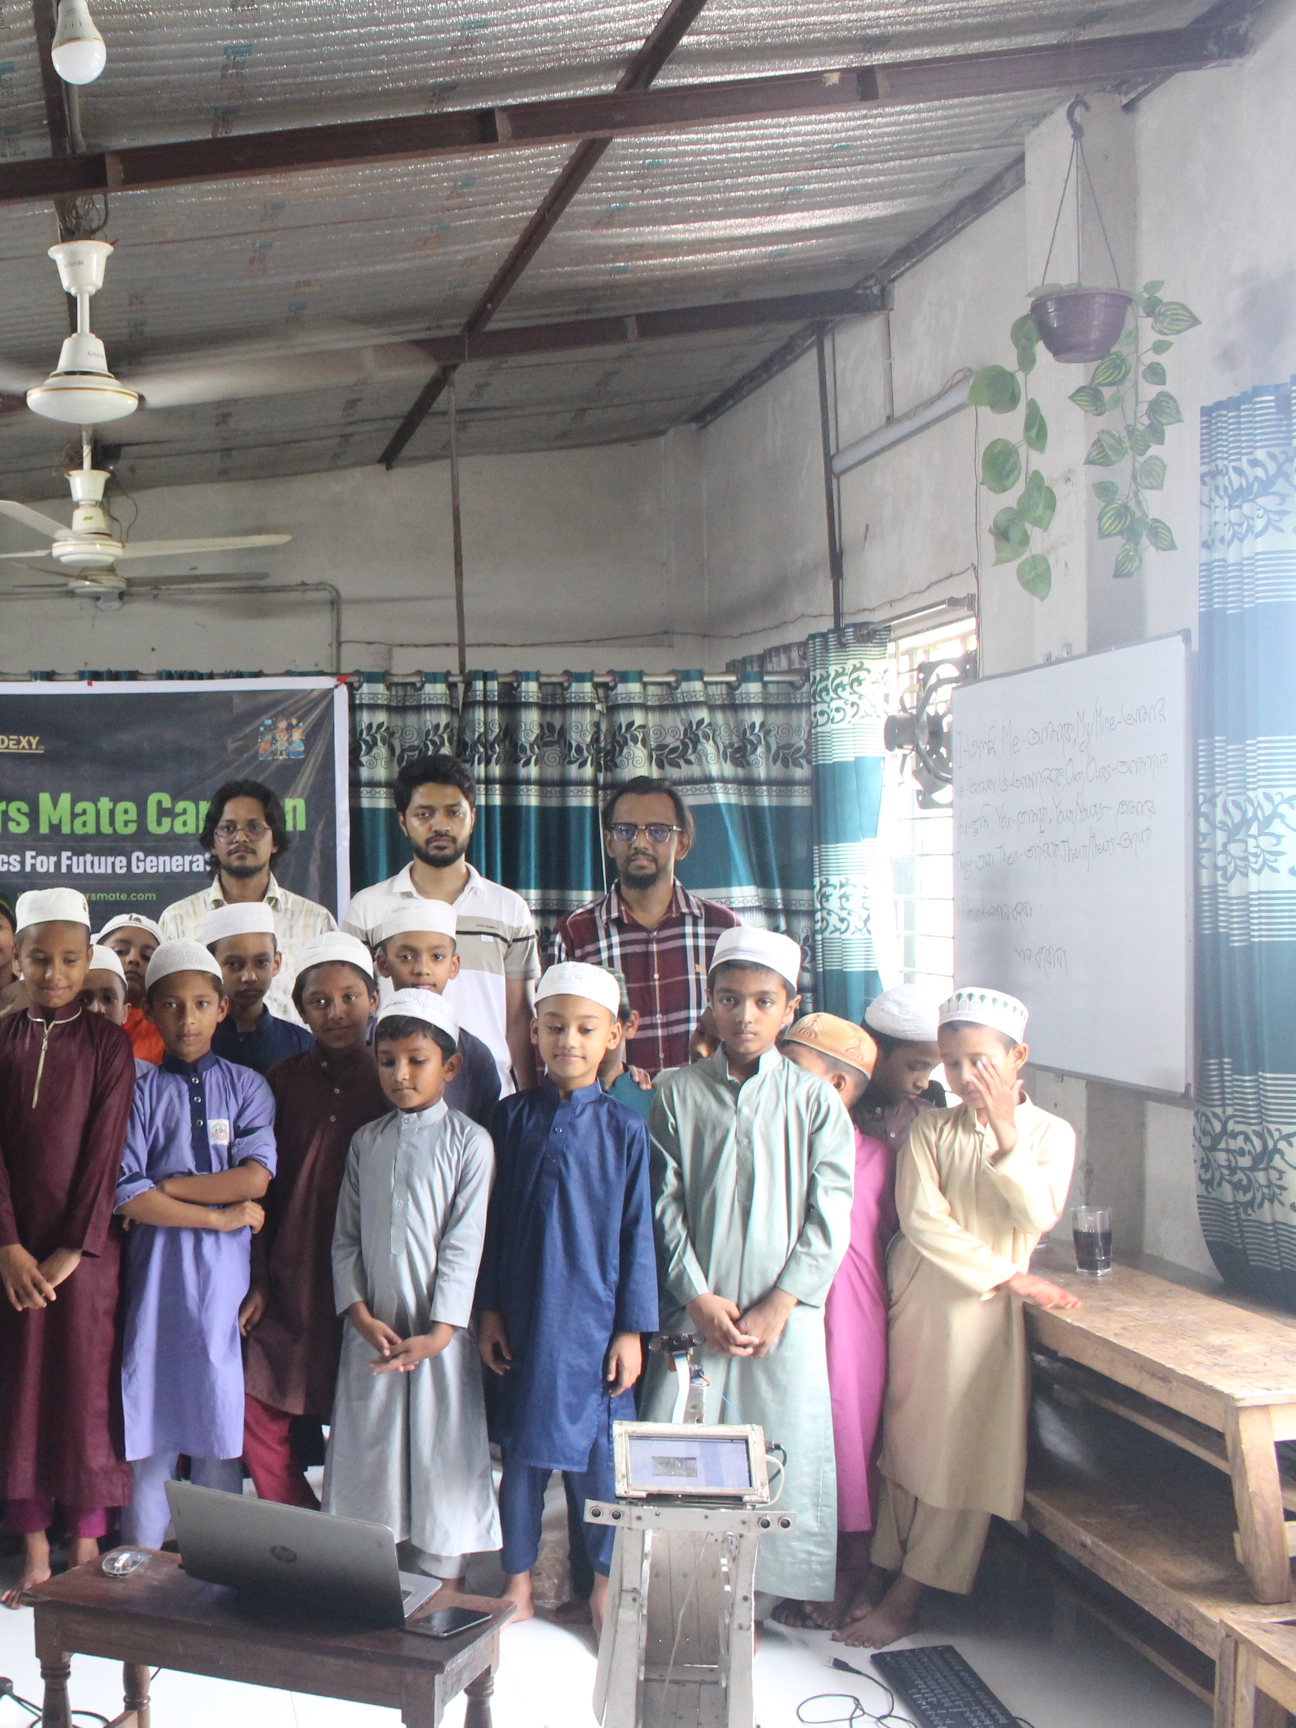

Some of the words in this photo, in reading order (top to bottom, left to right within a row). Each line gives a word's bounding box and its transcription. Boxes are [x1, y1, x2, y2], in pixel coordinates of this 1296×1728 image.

[38, 792, 138, 835] Mate
[24, 850, 57, 873] For
[60, 850, 127, 875] Future
[131, 850, 212, 874] Genera
